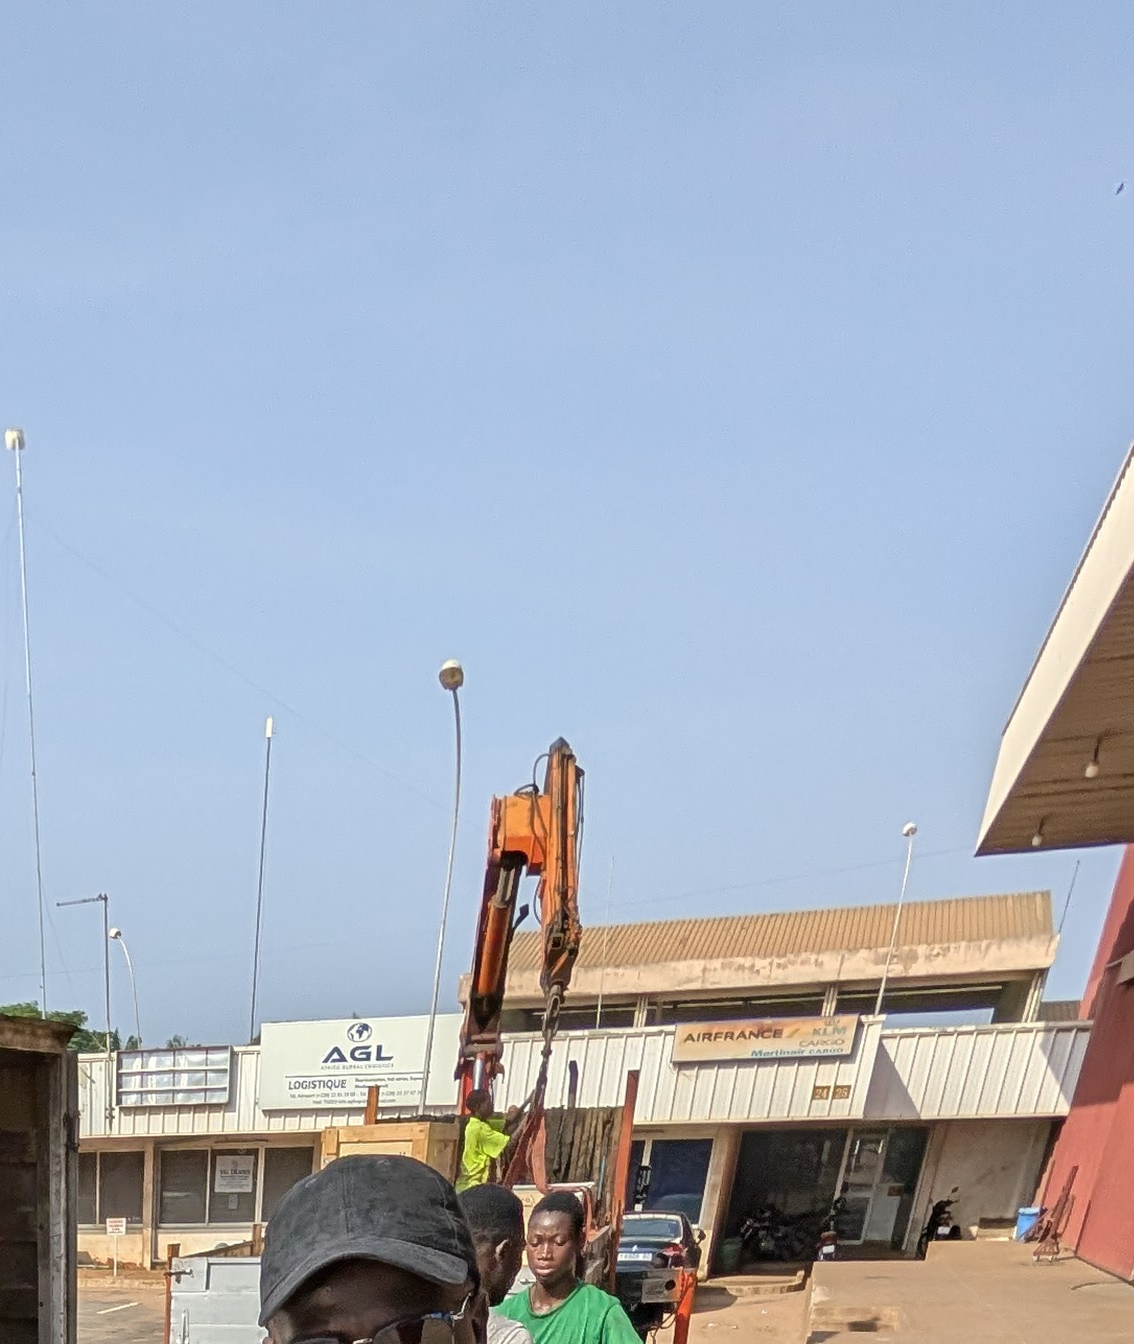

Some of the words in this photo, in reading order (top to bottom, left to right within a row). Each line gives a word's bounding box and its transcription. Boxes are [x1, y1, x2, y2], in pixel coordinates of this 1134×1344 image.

[683, 1028, 784, 1043] AIRFRANCE
[322, 1044, 394, 1063] AGL
[288, 1079, 347, 1090] LOGISTIQUE
